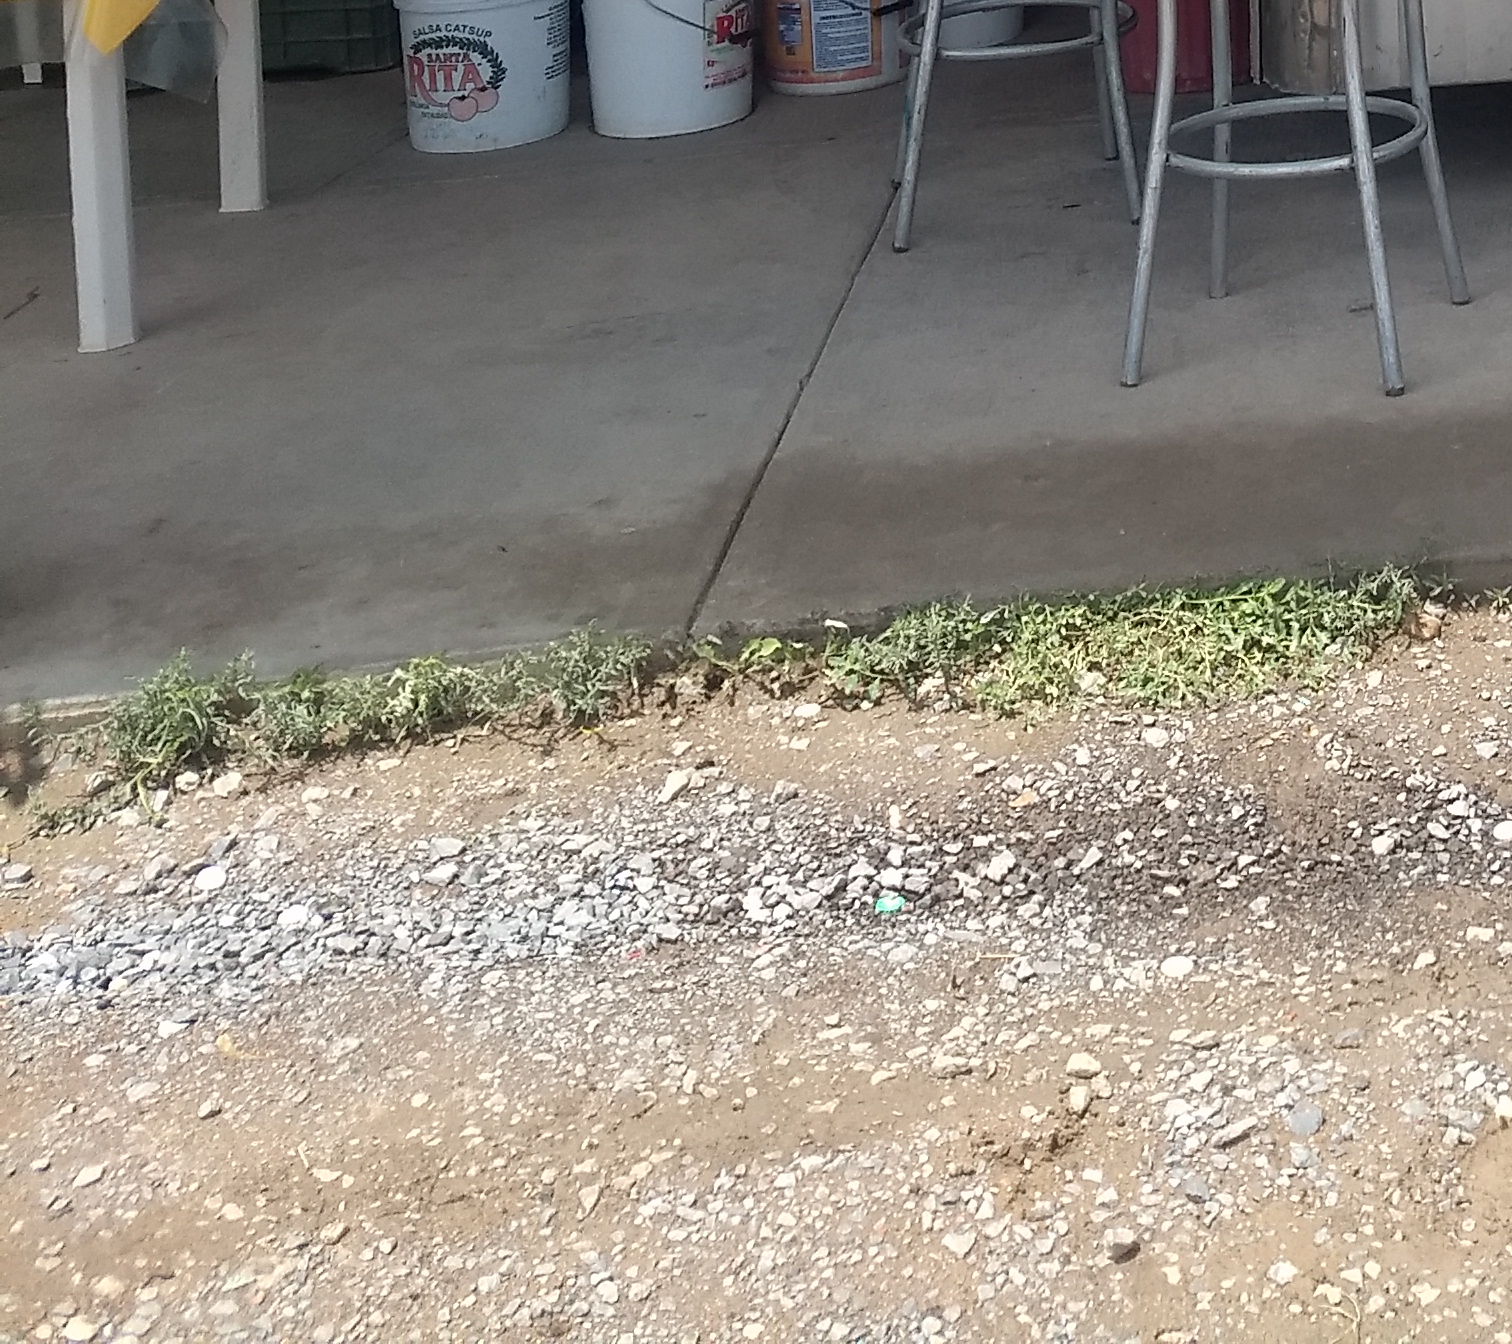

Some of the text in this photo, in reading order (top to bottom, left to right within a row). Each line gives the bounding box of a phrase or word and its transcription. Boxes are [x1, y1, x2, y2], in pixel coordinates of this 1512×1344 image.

[412, 22, 493, 40] SALSA CATSUP
[426, 52, 473, 63] SANTA
[406, 54, 486, 106] RITA
